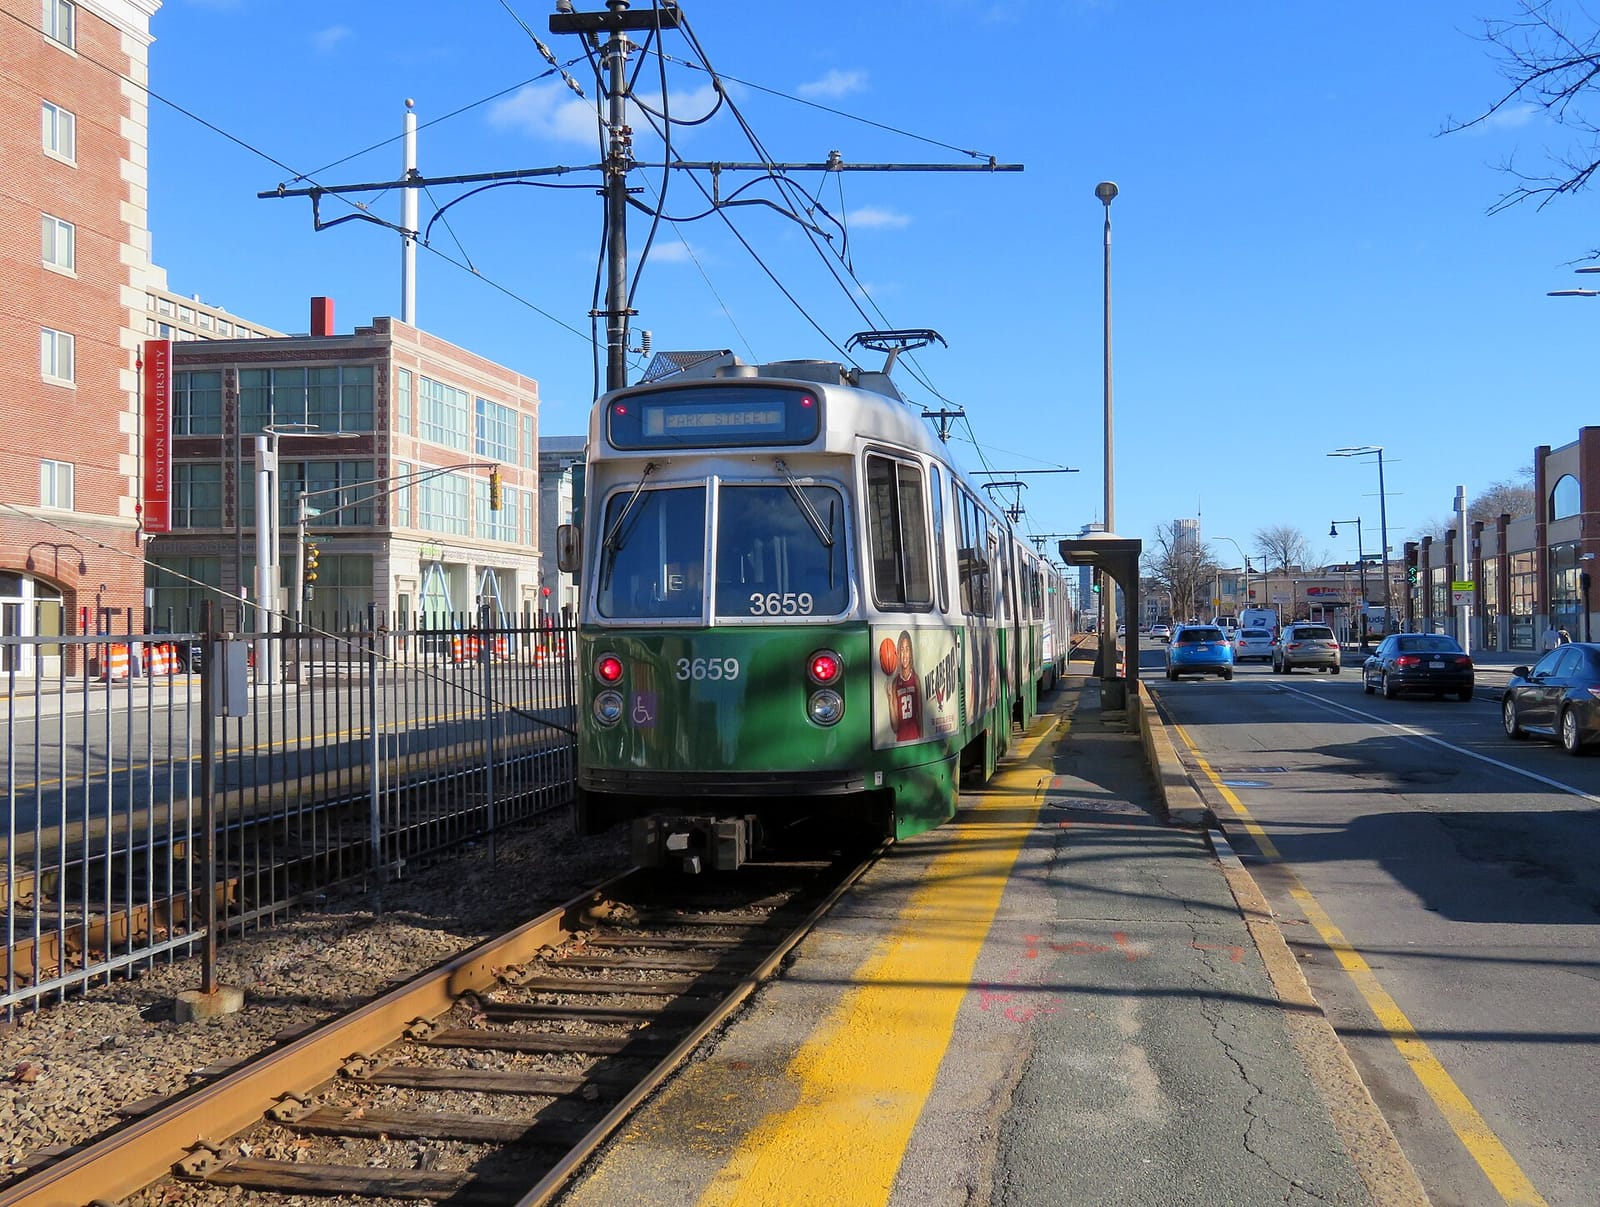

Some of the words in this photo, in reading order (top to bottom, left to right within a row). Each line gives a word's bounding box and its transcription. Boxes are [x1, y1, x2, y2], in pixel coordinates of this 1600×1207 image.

[156, 350, 165, 432] UNIVERSITY
[668, 415, 704, 427] PARK
[156, 438, 164, 492] BOSTON
[750, 593, 813, 615] 3659
[676, 658, 739, 680] 3659
[925, 670, 935, 700] WE
[901, 694, 913, 720] 23
